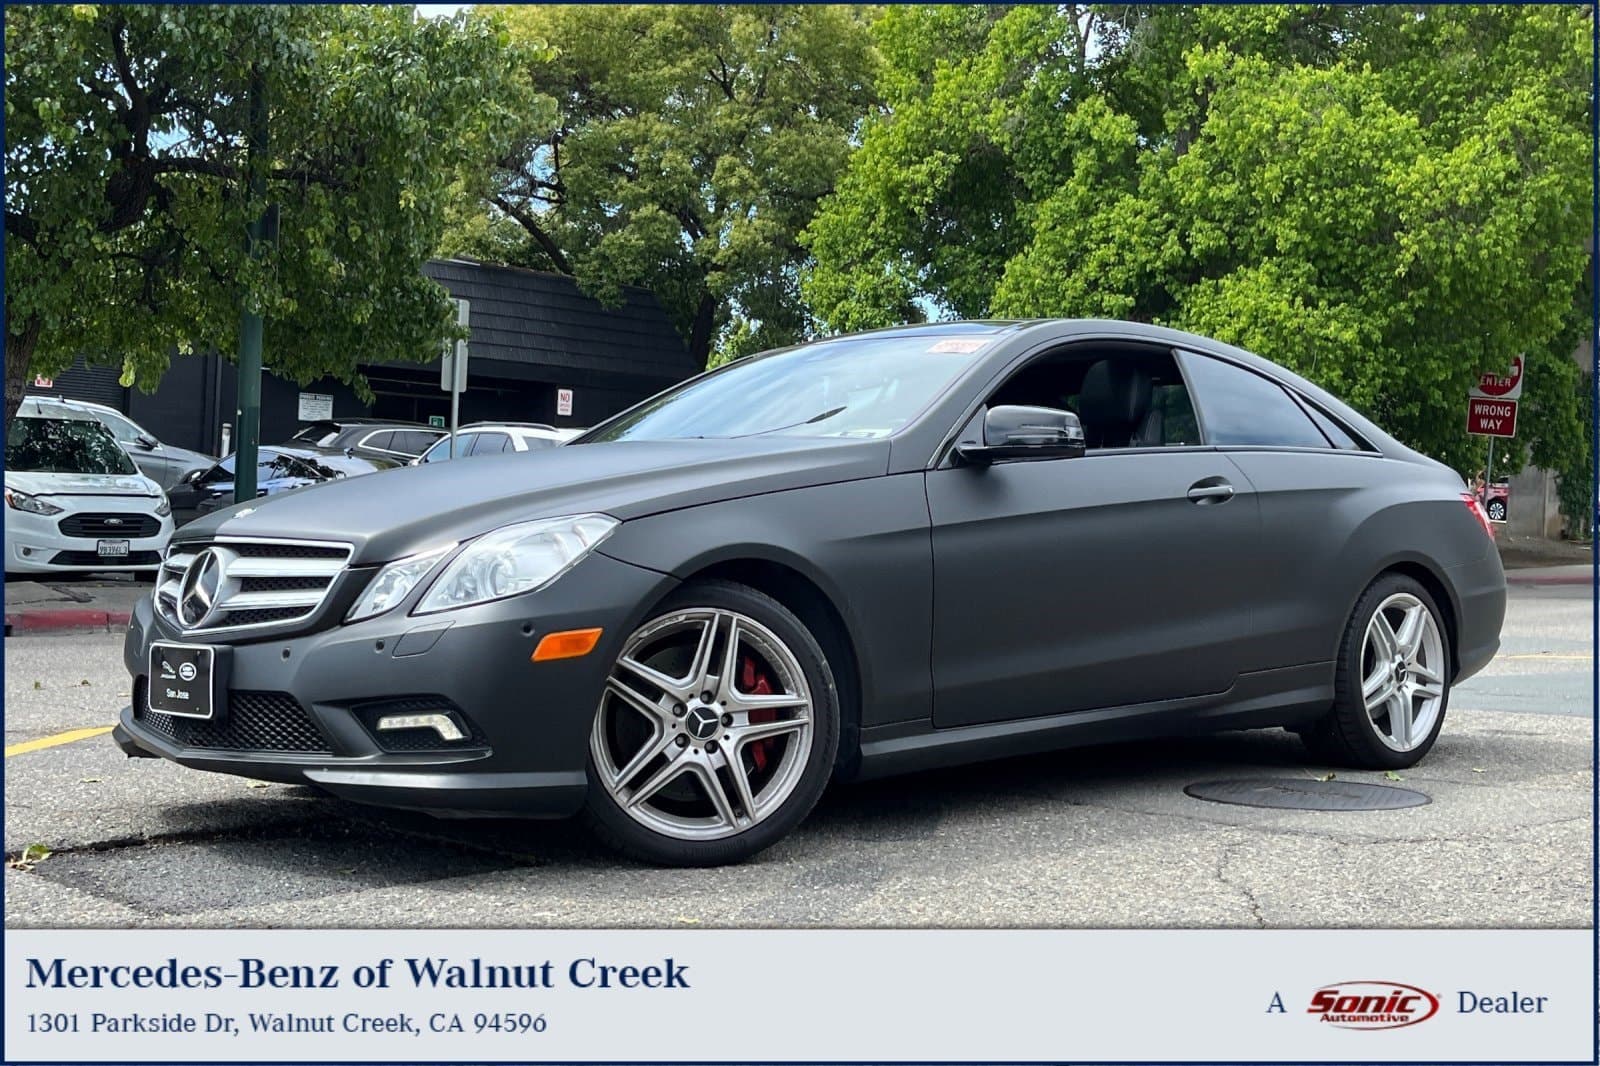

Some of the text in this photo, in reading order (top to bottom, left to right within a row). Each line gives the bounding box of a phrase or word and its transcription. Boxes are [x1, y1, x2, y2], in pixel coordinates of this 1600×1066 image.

[1480, 375, 1511, 387] ENTER
[560, 392, 570, 402] NO
[1474, 404, 1511, 417] WRONG
[1480, 418, 1503, 430] WAY
[166, 688, 177, 698] San
